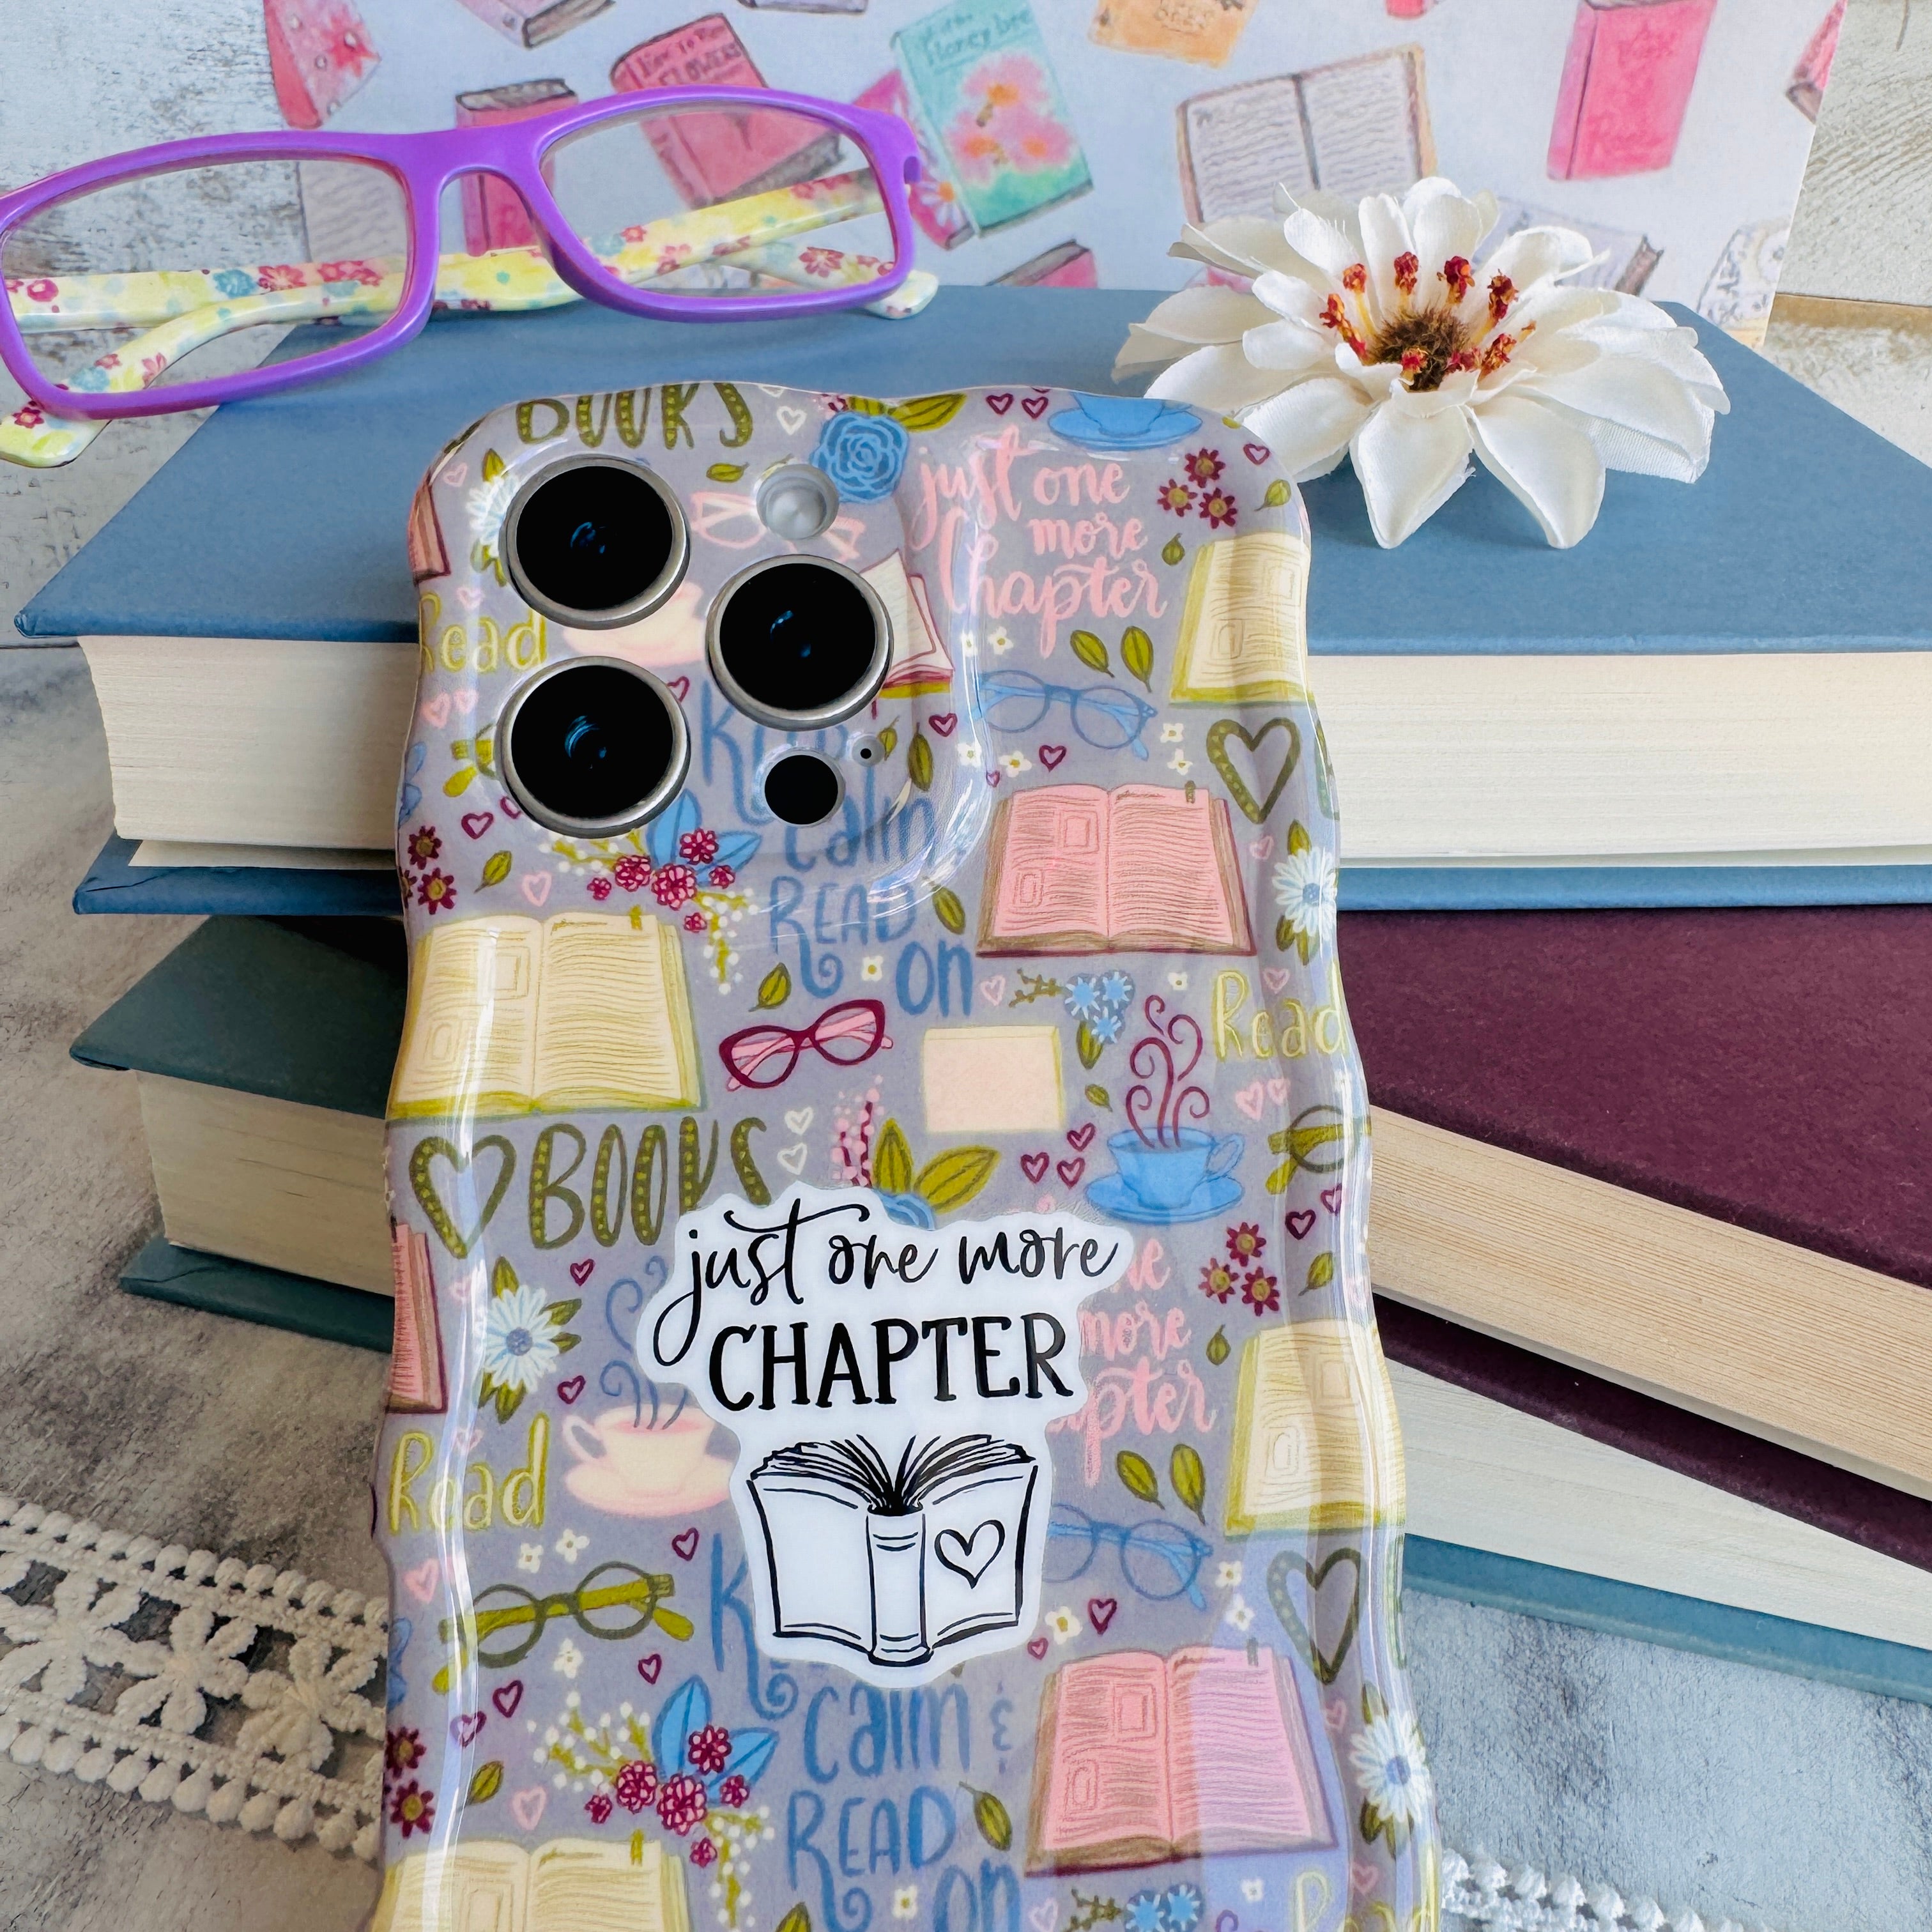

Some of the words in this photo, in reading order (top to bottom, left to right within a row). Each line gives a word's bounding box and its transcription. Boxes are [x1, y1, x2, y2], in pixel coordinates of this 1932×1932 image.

[912, 424, 1044, 550] just
[1033, 463, 1130, 506] one
[1027, 512, 1148, 560] more
[1211, 960, 1348, 1063] Read
[653, 1198, 870, 1367] just
[829, 1234, 939, 1289] one
[958, 1226, 1119, 1284] more
[709, 1312, 1075, 1411] CHAPTER
[390, 1412, 549, 1533] Read
